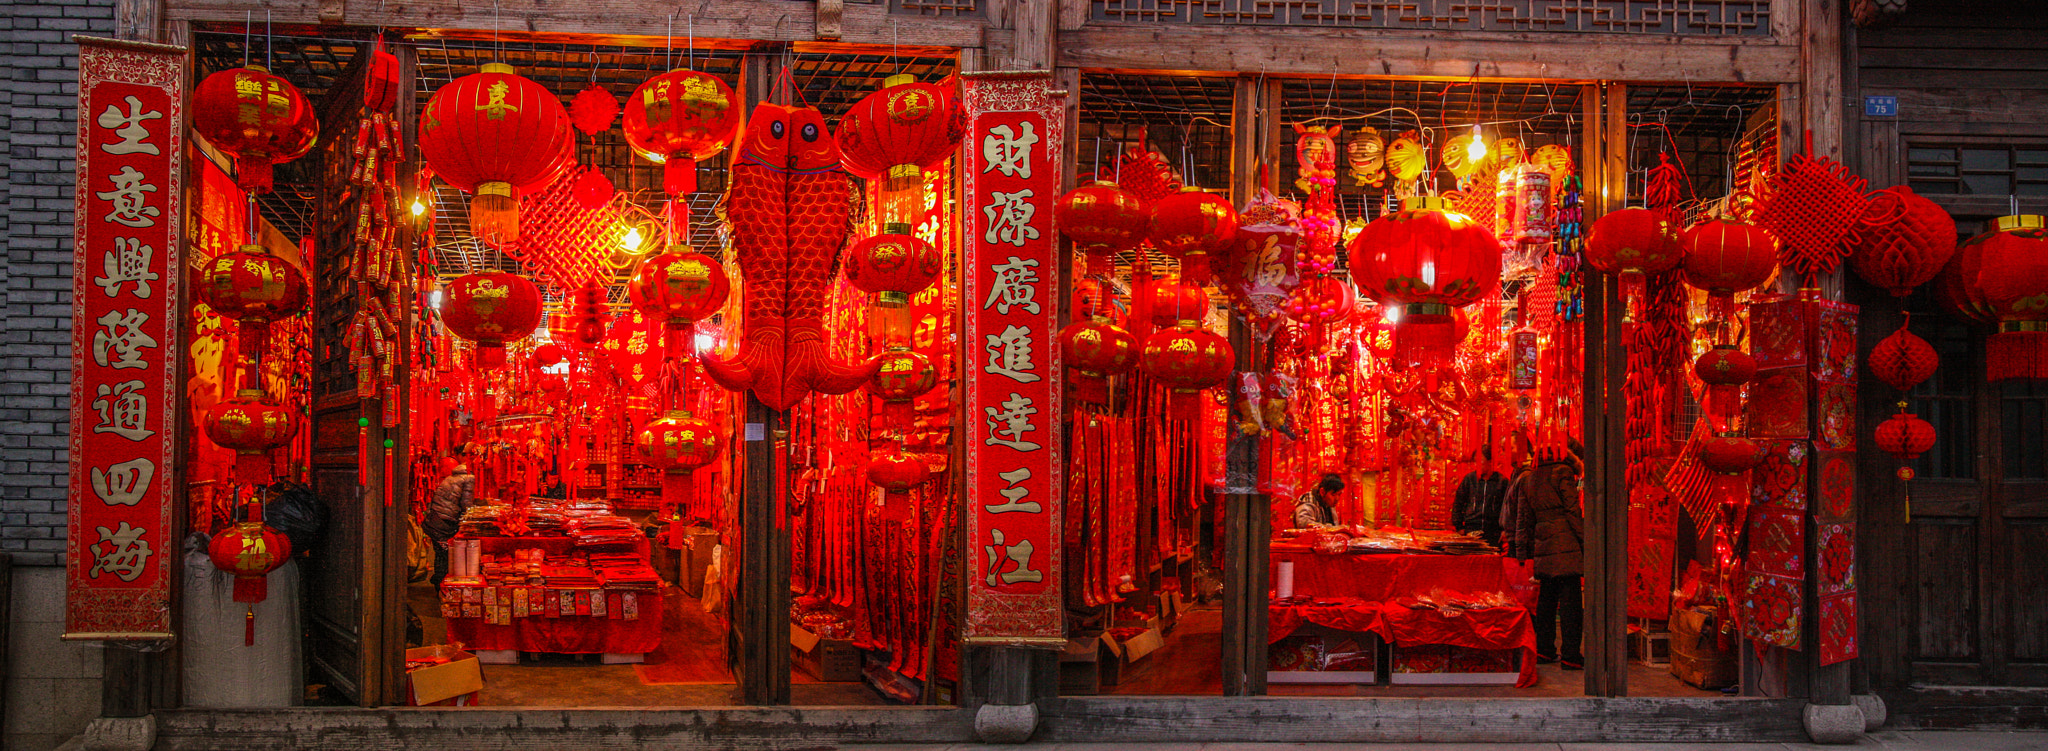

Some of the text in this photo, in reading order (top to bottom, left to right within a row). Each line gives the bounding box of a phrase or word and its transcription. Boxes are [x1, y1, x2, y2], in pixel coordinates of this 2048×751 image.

[474, 79, 518, 121] 喜
[892, 91, 929, 118] 喜
[1875, 105, 1887, 113] 75
[1239, 234, 1287, 288] 福
[89, 95, 163, 583] 生意興隆通四海
[626, 330, 649, 355] 福
[982, 120, 1043, 587] 財源廣進達三江
[1375, 329, 1393, 350] 福
[232, 537, 275, 572] 福
